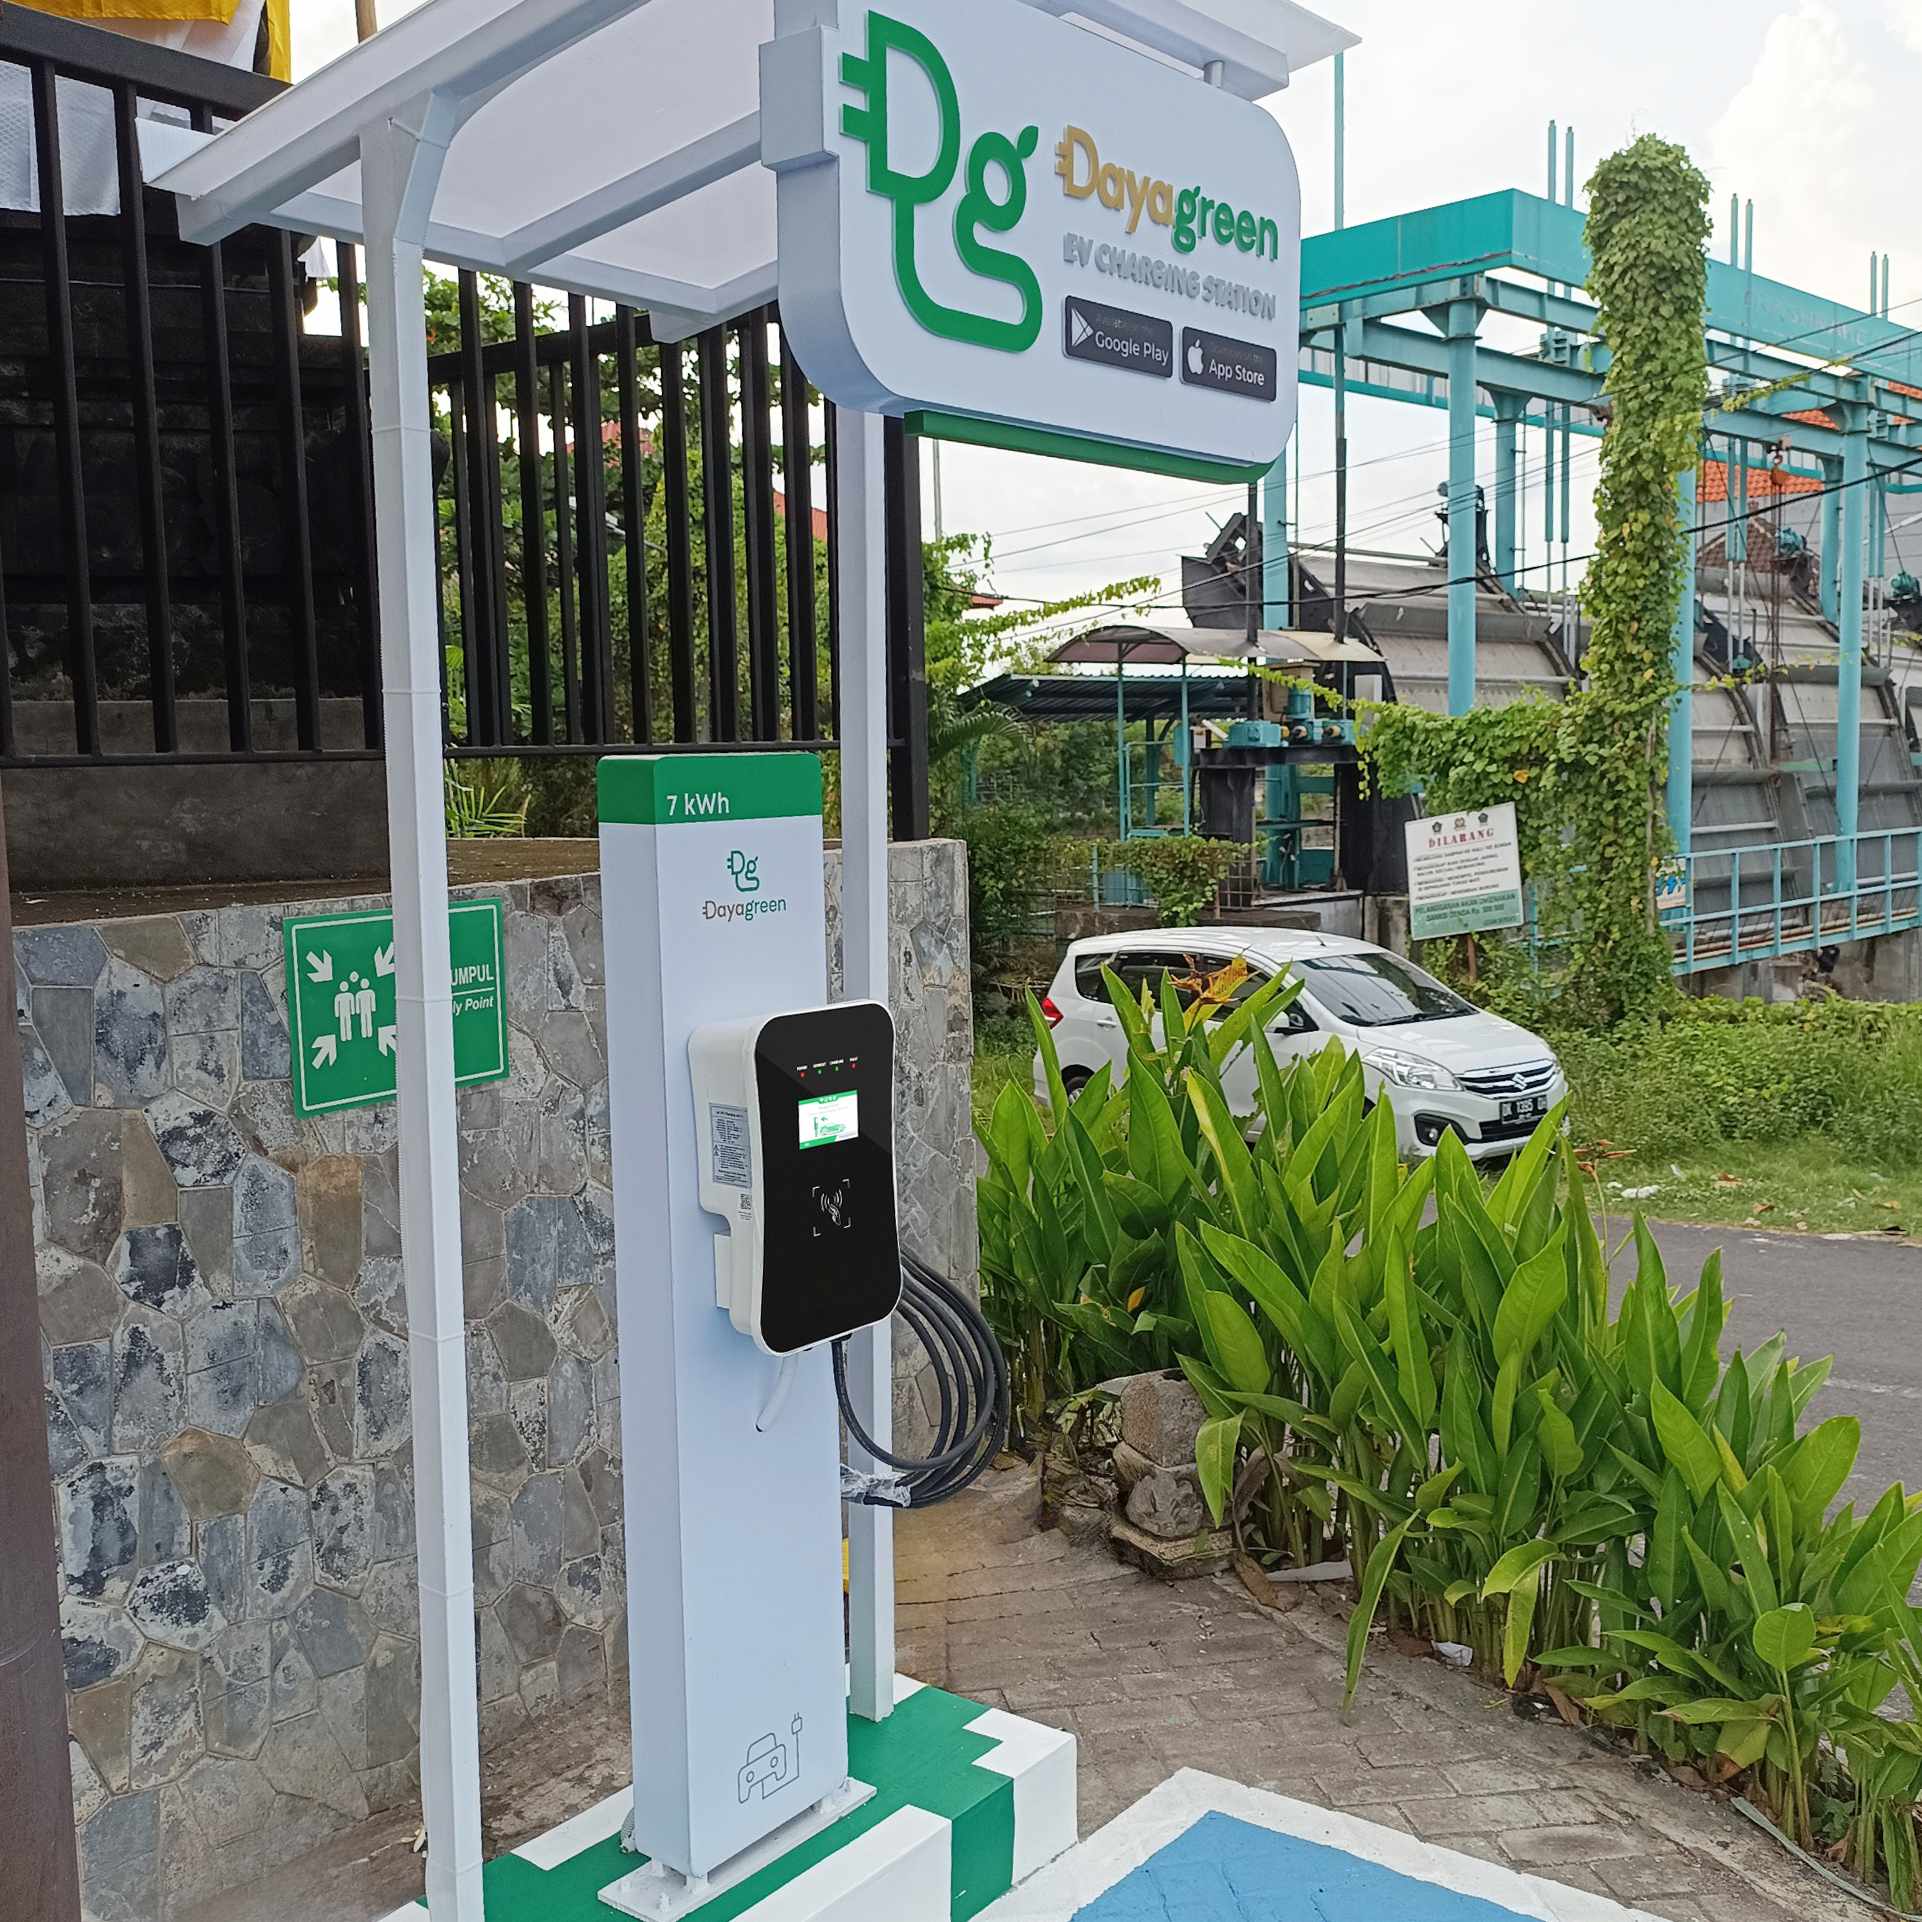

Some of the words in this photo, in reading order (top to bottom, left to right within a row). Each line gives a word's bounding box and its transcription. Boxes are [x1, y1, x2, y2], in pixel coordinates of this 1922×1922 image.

[1055, 124, 1279, 262] Dayagreen
[1063, 232, 1094, 267] EV
[1094, 243, 1201, 299] CHARGING
[1202, 275, 1276, 321] STATION
[1095, 331, 1140, 358] Google
[1143, 342, 1169, 367] Play
[1208, 358, 1233, 381] App
[1235, 364, 1265, 386] Store
[666, 794, 678, 816] 7
[684, 792, 730, 816] kWh
[1428, 828, 1494, 848] DILARANG
[702, 898, 787, 922] Dayagreen
[465, 996, 494, 1011] Point
